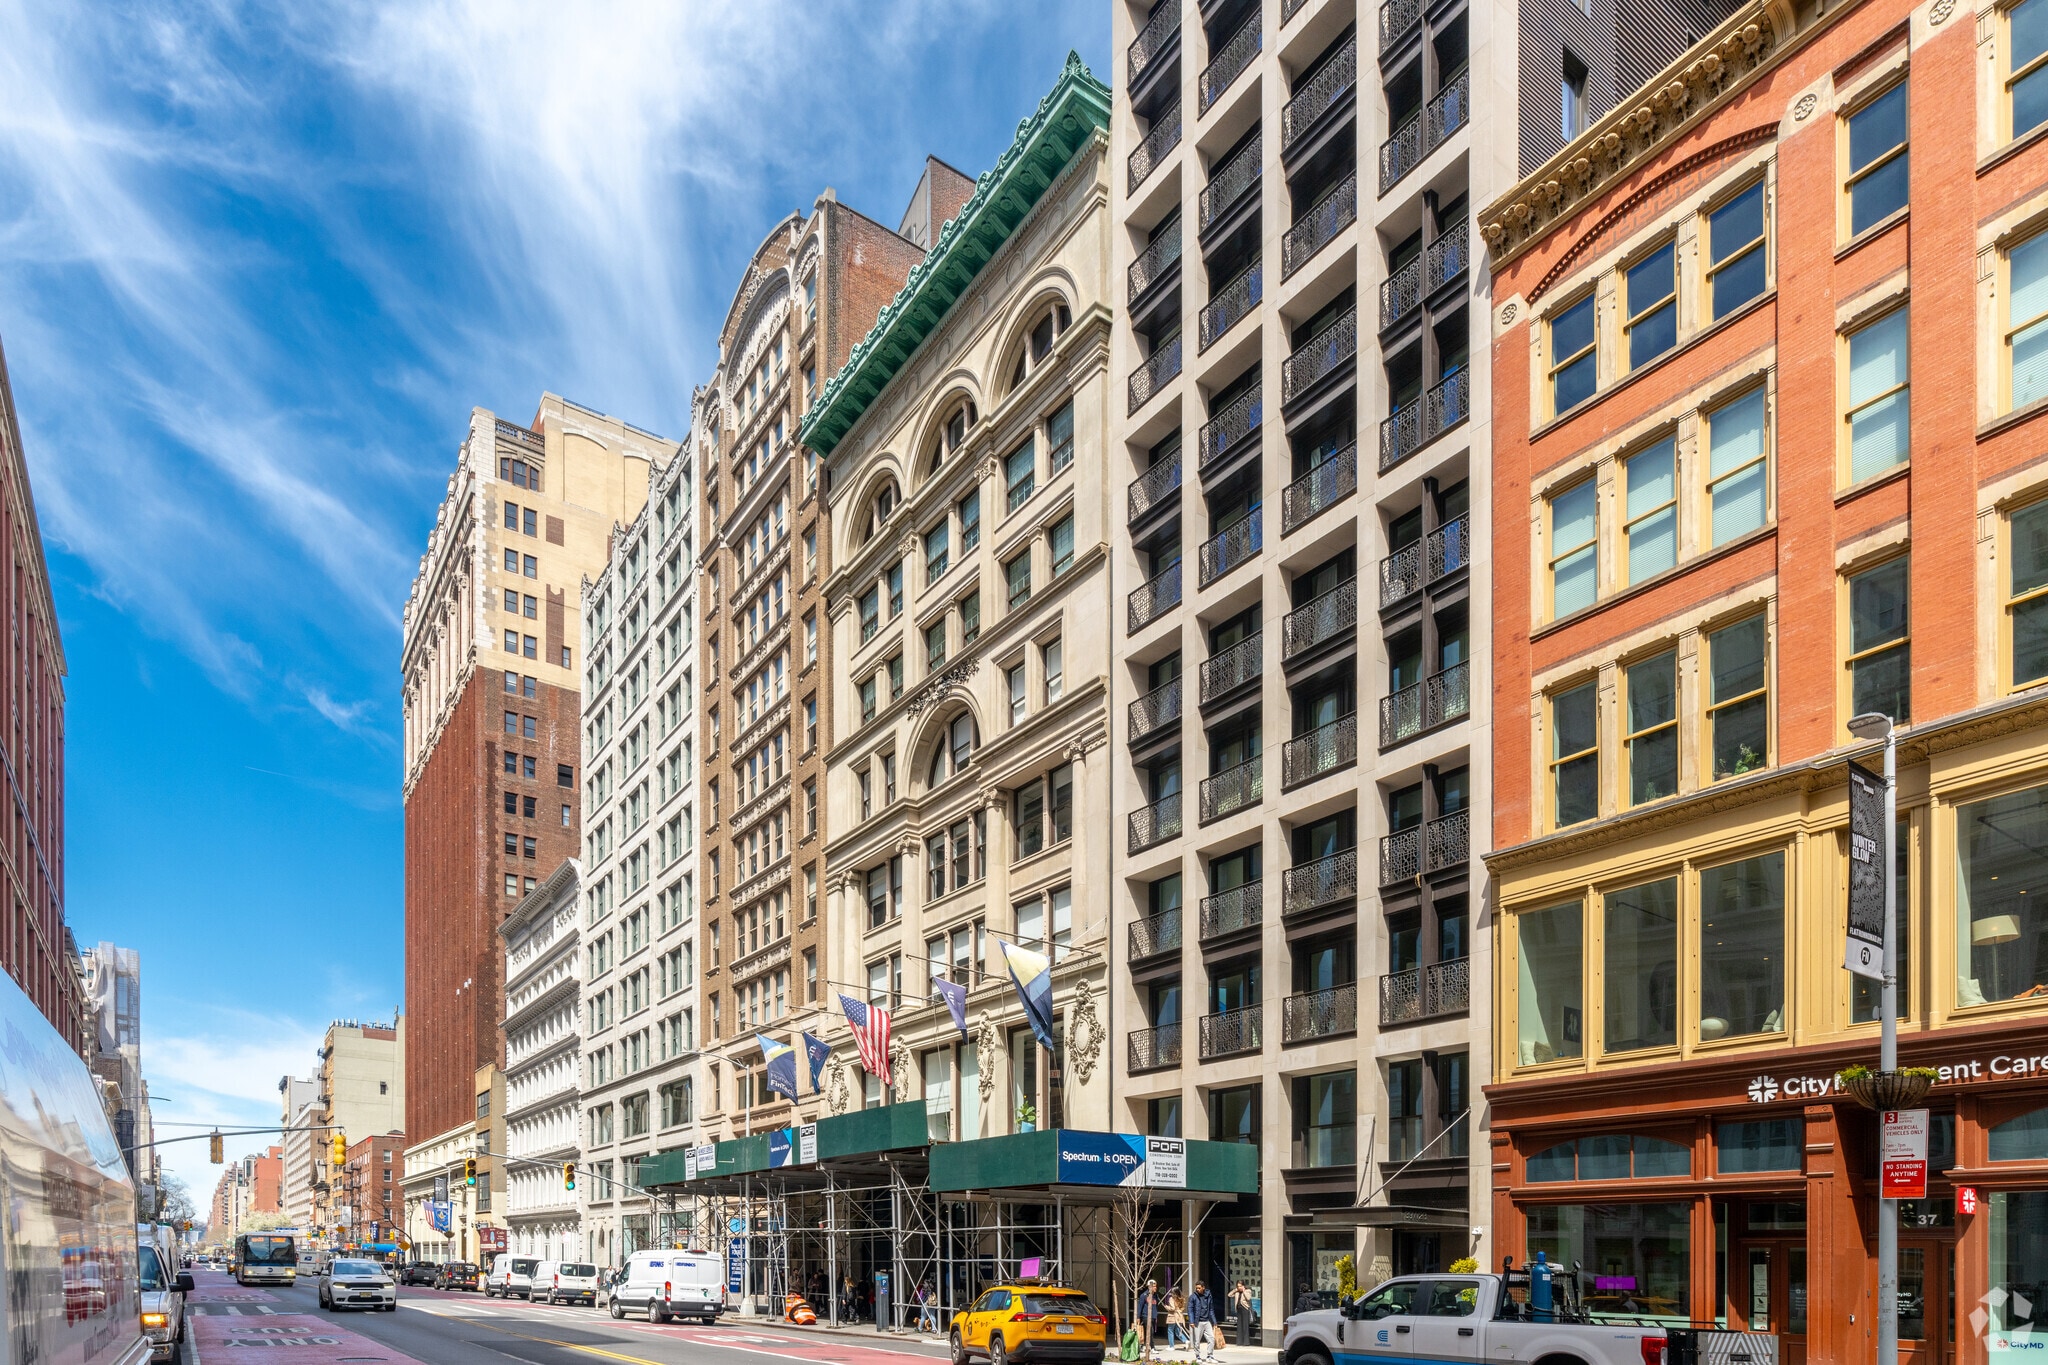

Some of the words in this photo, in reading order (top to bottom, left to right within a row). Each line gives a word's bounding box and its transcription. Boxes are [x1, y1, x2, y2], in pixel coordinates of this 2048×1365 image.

[1852, 832, 1876, 854] WINTER
[1852, 846, 1870, 864] GLOW
[1990, 1055, 2048, 1076] Care
[1887, 1112, 1895, 1123] 3
[1150, 1141, 1182, 1153] POFI
[1062, 1150, 1099, 1163] Spectrum
[1103, 1152, 1111, 1163] is
[1112, 1153, 1138, 1165] OPEN
[1917, 1214, 1938, 1225] 37
[225, 1338, 340, 1347] ONLY
